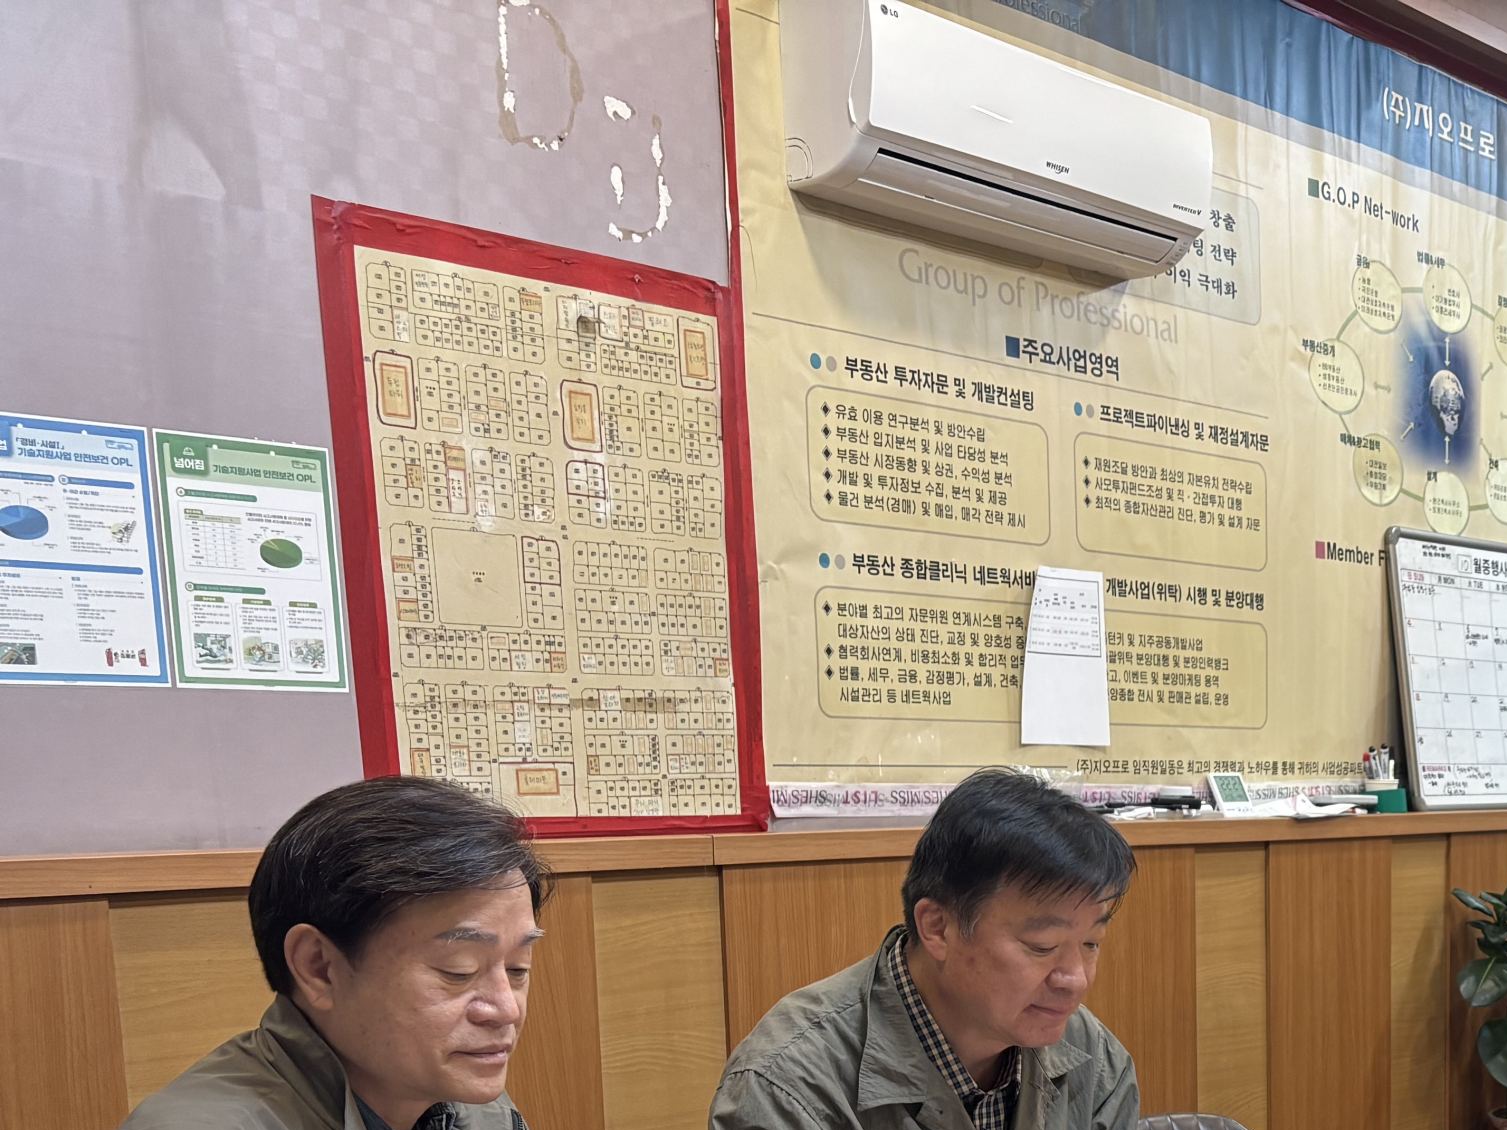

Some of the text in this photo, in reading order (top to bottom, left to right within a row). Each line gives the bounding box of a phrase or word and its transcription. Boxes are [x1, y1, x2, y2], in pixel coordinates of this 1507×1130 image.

[1046, 161, 1070, 174] WHISEN
[1321, 182, 1419, 232] G.O.P Net-work
[1209, 209, 1236, 232] 창출
[1188, 238, 1237, 266] 팅 전략
[898, 248, 1179, 344] Group of Professional
[1198, 273, 1237, 299] 극대화
[1022, 338, 1119, 382] 주요사업영역
[845, 356, 1035, 412] 부동산 투자자문 및 개발컨설팅
[835, 404, 986, 442] 유효 이용 연구분석 및 방안수립
[1100, 405, 1269, 452] 프로젝트파이낸싱 및 재정설계자문
[18, 448, 72, 460] 기술지원사업
[111, 456, 133, 467] OPL
[836, 426, 1009, 466] 부동산 입지분석 및 사업 타당성 분석
[174, 457, 205, 470] 넘어짐
[837, 448, 1013, 487] 부동산 시장동향 및 상권, 수익성 분석
[1094, 457, 1253, 495] 재원조달 방안과 최상의 자본유치 전략수립
[296, 474, 317, 483] OPL
[837, 469, 1008, 506] 개발 및 투자정보 수집, 분석 및 제공
[1095, 477, 1163, 500] 사모투자펀드조성
[1166, 487, 1174, 501] 및
[1177, 489, 1185, 503] 직
[1193, 491, 1225, 510] 간접투자
[838, 491, 859, 507] 물건
[864, 495, 917, 515] 분석(경매)
[921, 501, 930, 517] 및
[961, 506, 981, 522] 매각
[984, 509, 1004, 526] 전략
[1007, 512, 1026, 528] 제시
[1095, 497, 1261, 532] 최적의 종합자산관리 진단, 평가 및 설계 자문
[1327, 542, 1374, 565] Member
[852, 553, 1036, 590] 부동산 종합클리닉 네트웍서비
[1474, 558, 1507, 578] 월중행사
[1106, 578, 1265, 611] 개발사업(위탁) 시행 및 분양대행
[837, 602, 868, 619] 분야별
[872, 607, 904, 622] 최고의
[908, 608, 948, 625] 자문위원
[952, 611, 1003, 628] 연계시스템
[838, 623, 1012, 649] 대상자산의 상태 진단, 교정 및 양호성
[1105, 631, 1203, 652] 턴키 지주공동개발사업
[838, 644, 1007, 668] 협력회사연계, 비용최소화 합리적
[1105, 650, 1229, 671] 괄위탁 분양대행 분양인력뱅크
[839, 666, 864, 682] 법률,
[868, 669, 893, 683] 세무,
[898, 670, 922, 684] 금융,
[926, 671, 969, 687] 감정평가,
[973, 673, 996, 688] 설계,
[1123, 670, 1148, 685] 이벤트
[1162, 673, 1201, 688] 분양마케팅
[1204, 676, 1220, 688] 용역
[840, 688, 952, 705] 시설관리 등 네트웍사업
[1137, 689, 1154, 703] 전시
[1168, 692, 1192, 705] 판매관
[1214, 693, 1229, 706] 운영
[1076, 758, 1130, 776] (주)지오프로
[1132, 759, 1185, 775] 임직원일동은
[1187, 760, 1211, 774] 최고의
[1247, 761, 1279, 776] 노하우를
[1281, 761, 1297, 777] 통해
[1298, 761, 1320, 777] 귀하의
[1321, 761, 1366, 776] 사업성공파트
